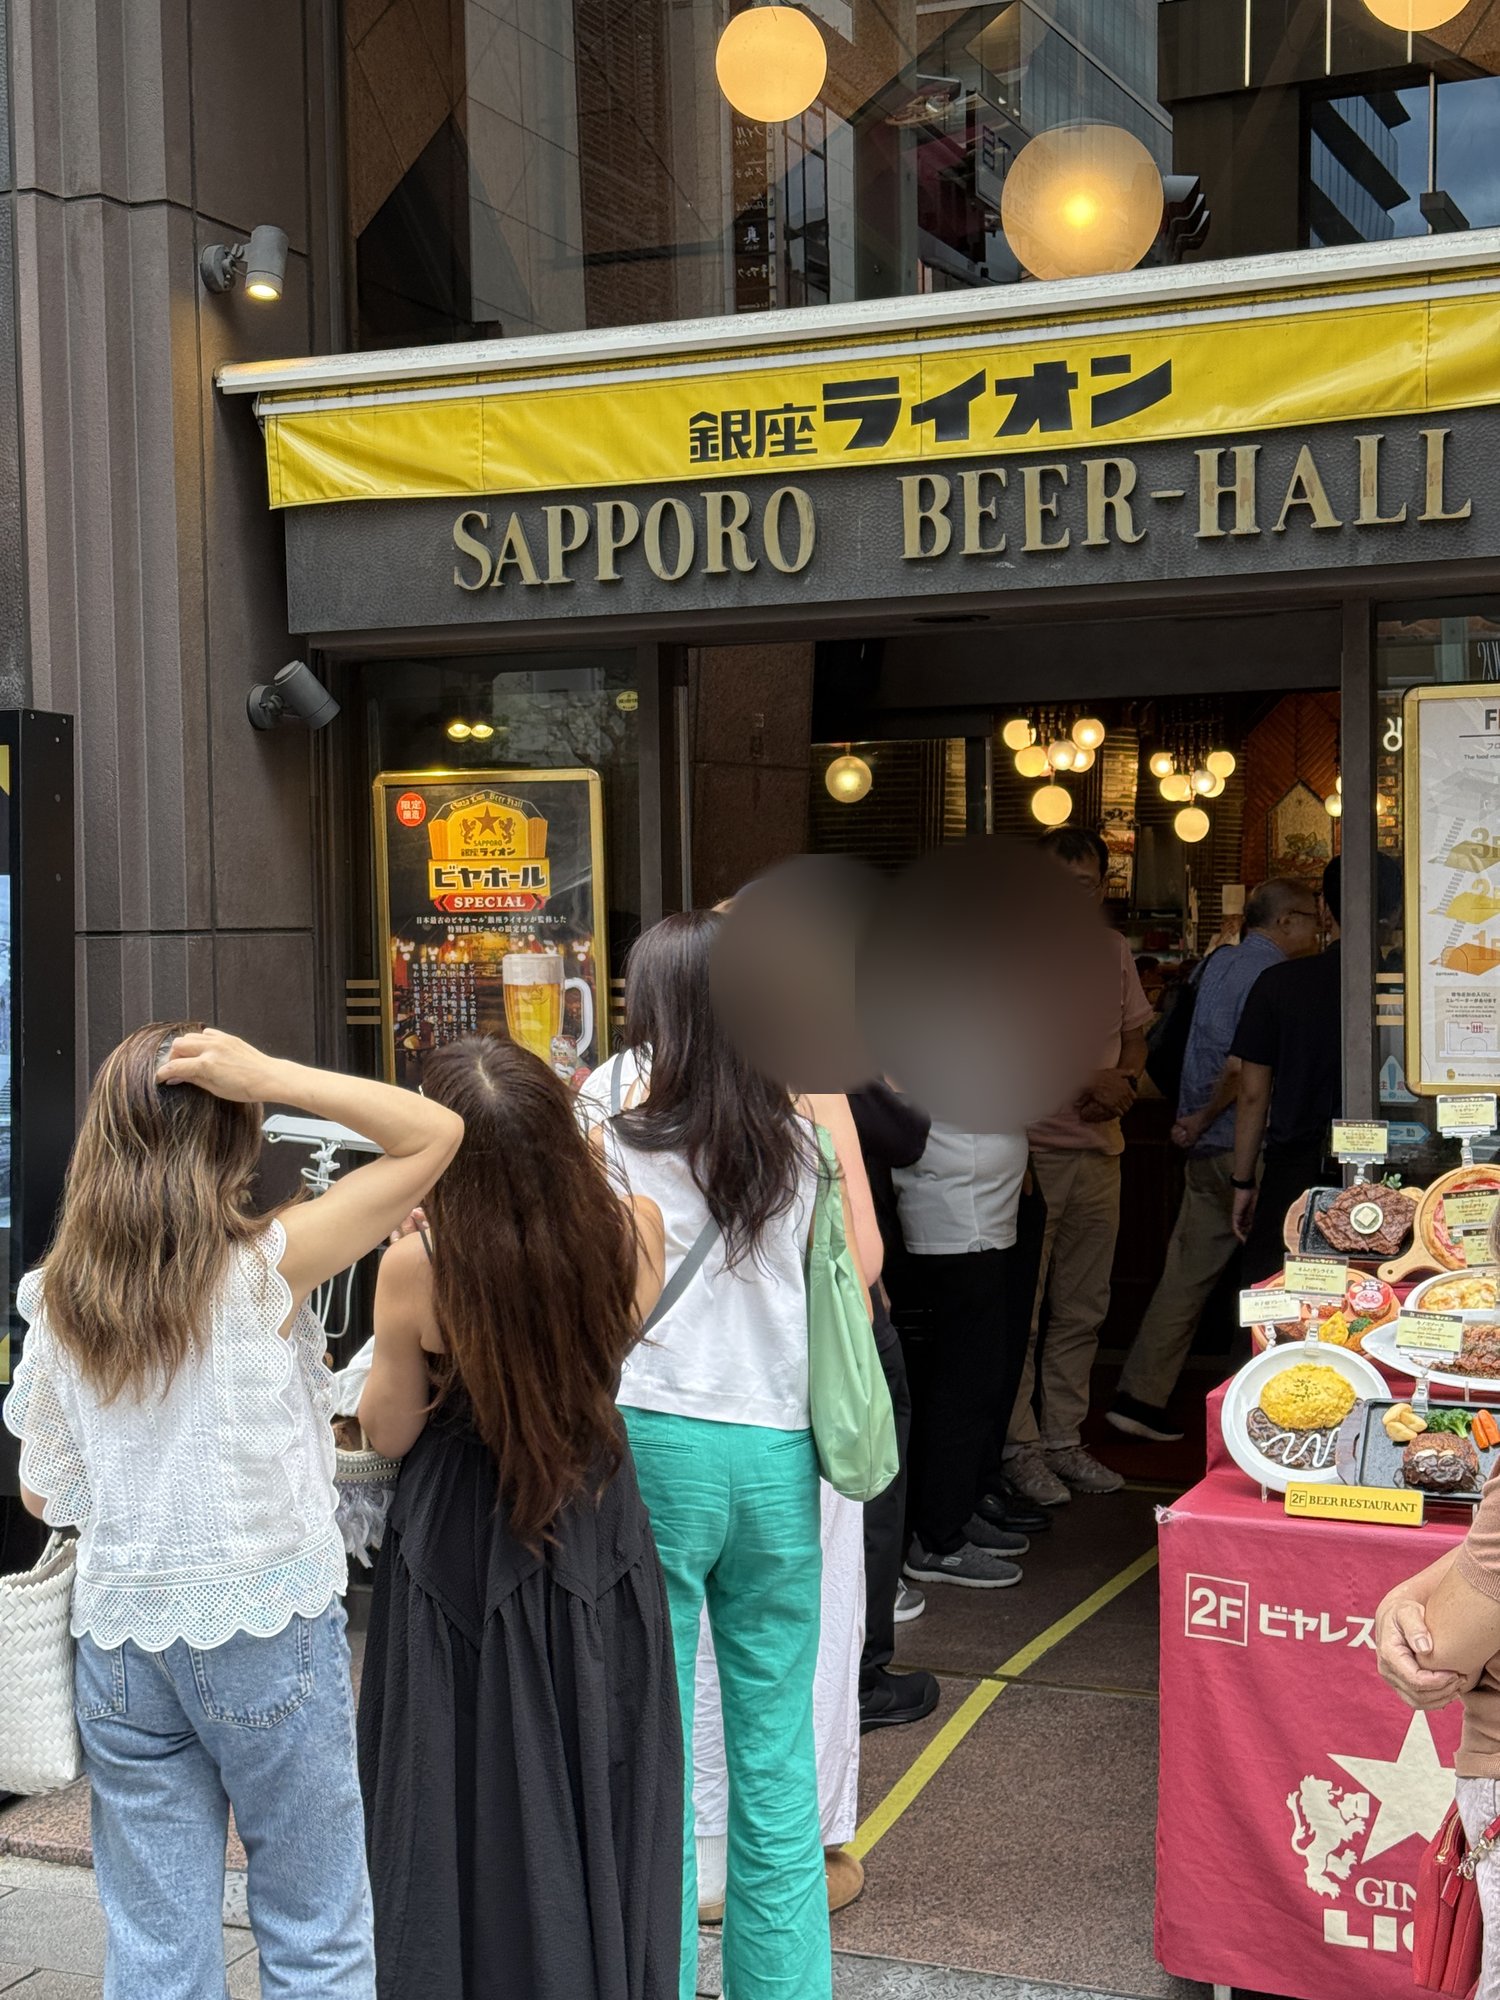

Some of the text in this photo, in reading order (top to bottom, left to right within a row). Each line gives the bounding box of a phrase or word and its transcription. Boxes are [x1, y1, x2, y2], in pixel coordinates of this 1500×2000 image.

[689, 353, 1173, 463] 銀座ライオン
[453, 427, 1474, 593] SAPPORO BEER-HALL
[400, 799, 422, 810] 限定
[474, 839, 503, 847] SAPPORO
[433, 865, 547, 889] ビヤホール
[453, 896, 526, 909] SPECIAL
[1291, 1493, 1417, 1512] 2F BEER RESTAURANT
[1190, 1587, 1377, 1650] 2F ビヤレス
[1355, 1877, 1417, 1912] GIN
